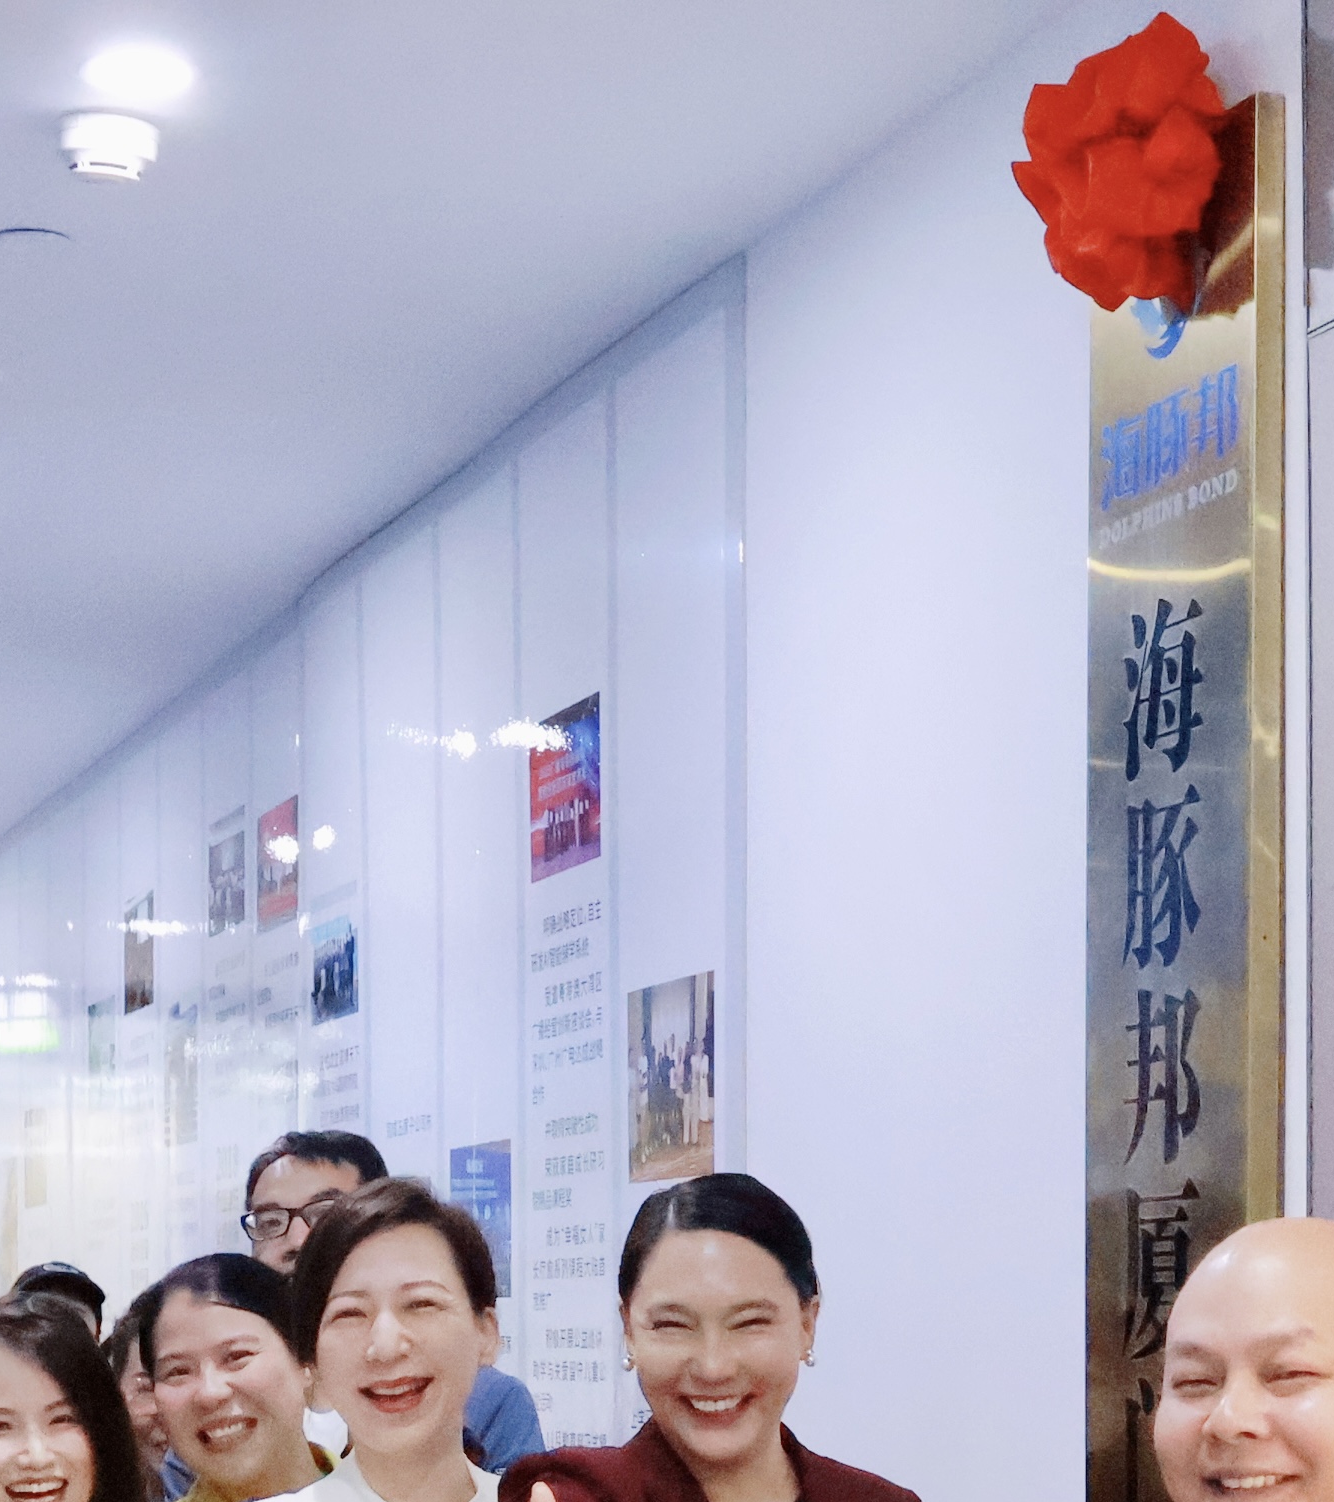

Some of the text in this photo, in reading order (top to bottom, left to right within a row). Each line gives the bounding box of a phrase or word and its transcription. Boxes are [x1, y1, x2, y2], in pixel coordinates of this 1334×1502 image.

[1100, 363, 1239, 511] 海豚邦
[1186, 468, 1240, 511] BOND
